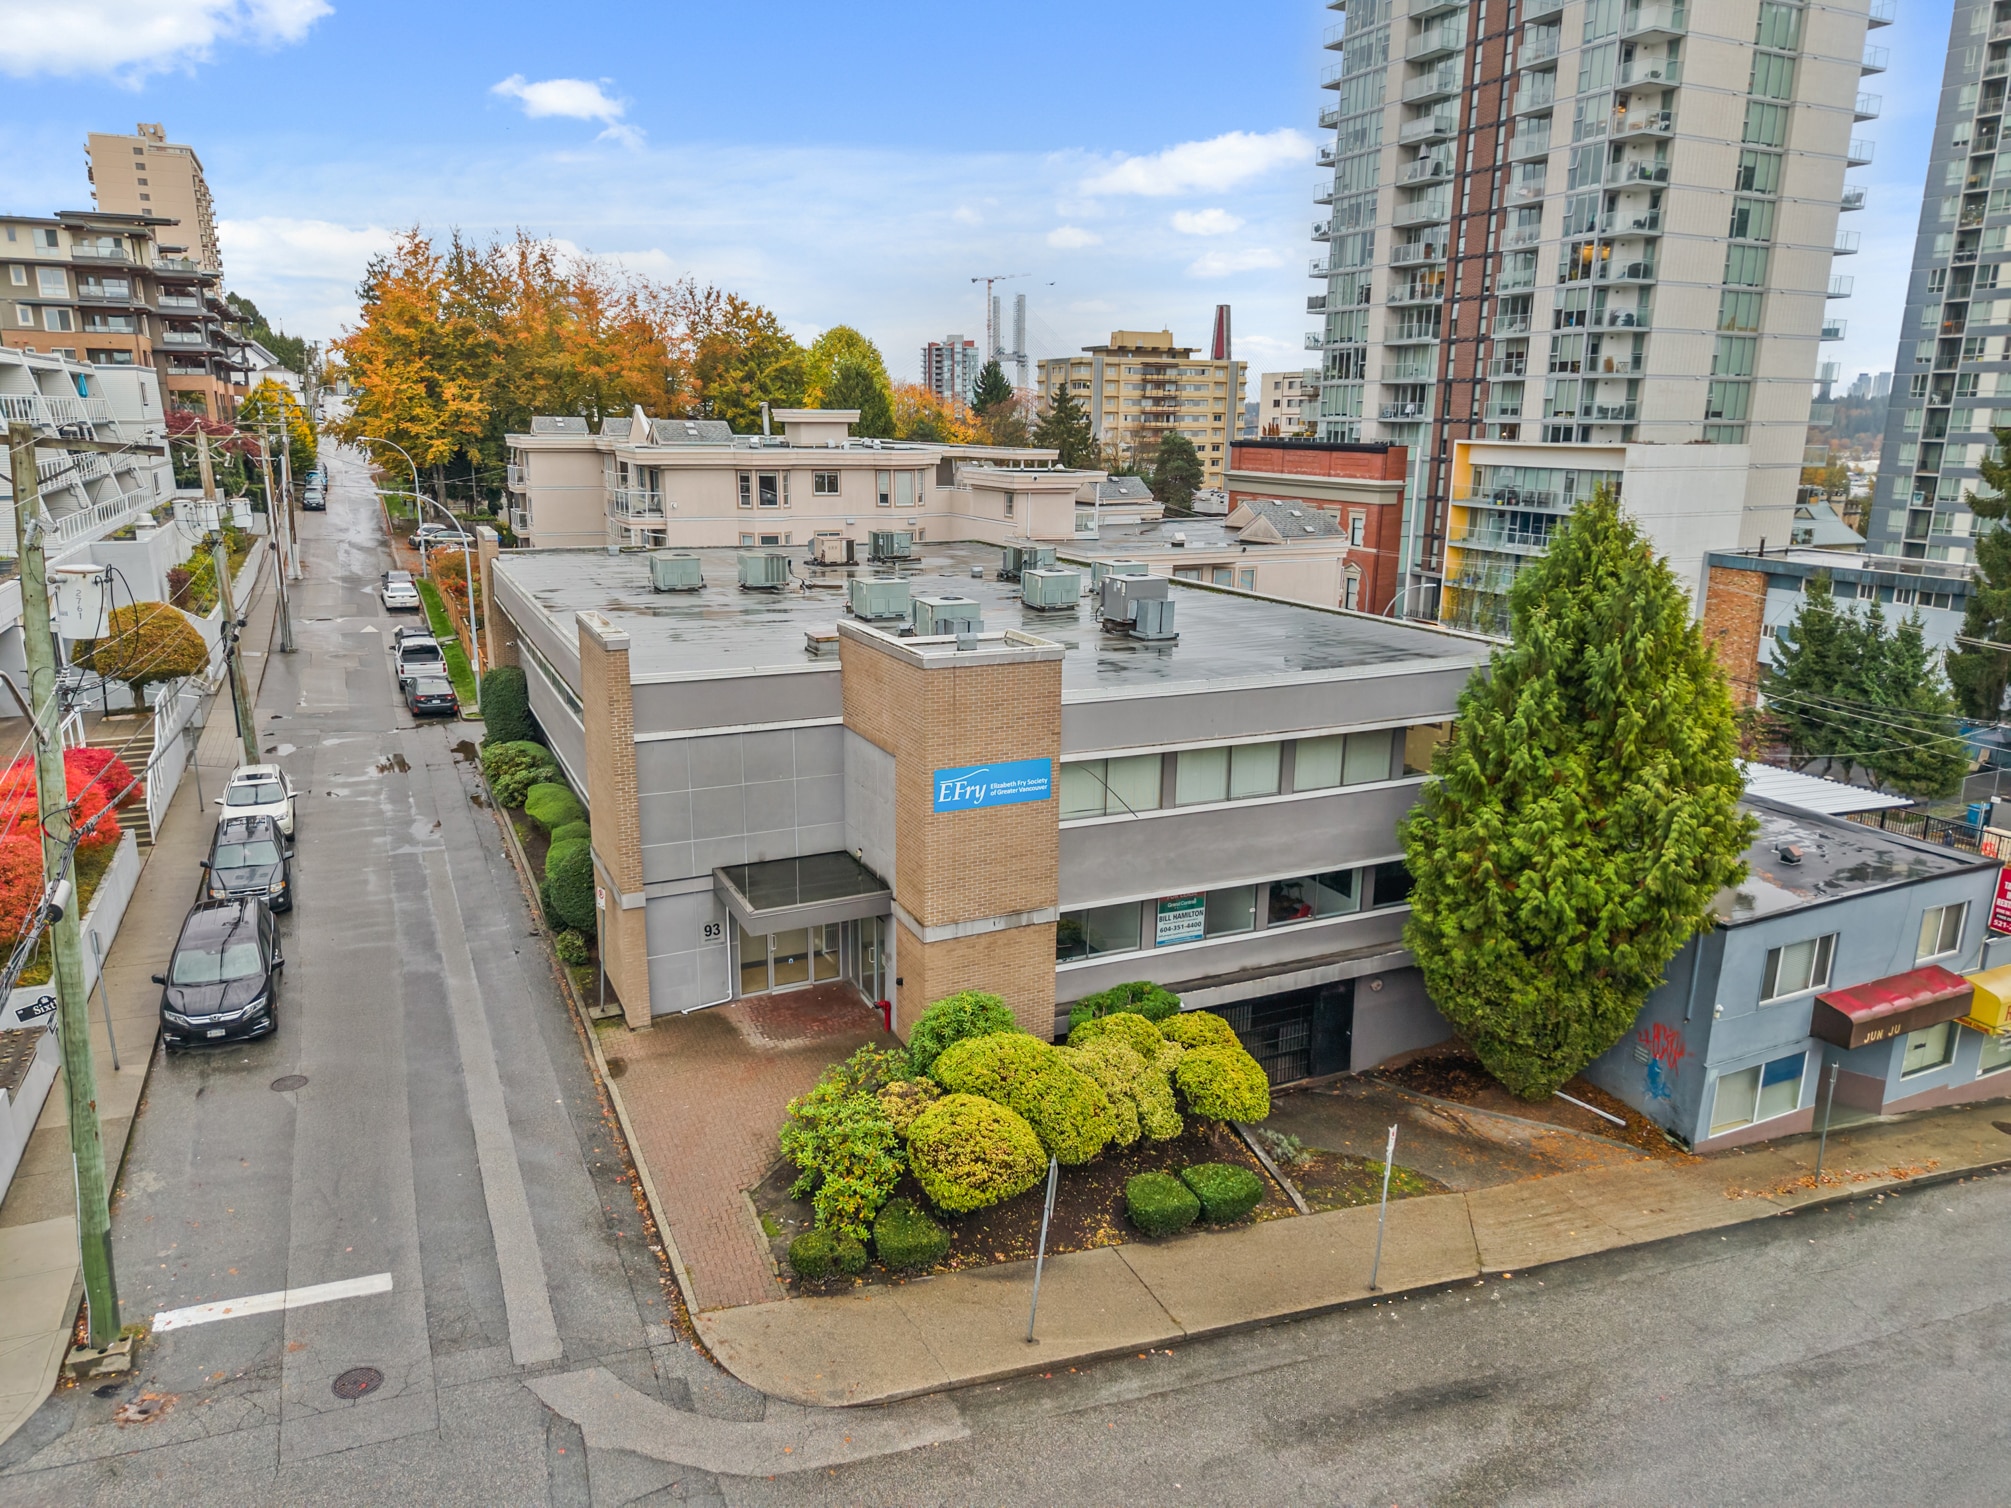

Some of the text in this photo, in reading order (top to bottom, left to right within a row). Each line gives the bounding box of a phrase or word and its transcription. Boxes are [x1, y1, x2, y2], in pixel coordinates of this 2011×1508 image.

[75, 589, 83, 620] 2761
[990, 777, 1048, 789] Elizabeth Fry Society
[997, 787, 1018, 796] Greater
[1018, 784, 1048, 793] Vancouver
[1172, 910, 1204, 920] HAMILTON
[704, 923, 721, 937] 93
[1160, 922, 1202, 933] 604-351-4400
[1864, 1024, 1901, 1043] JUN JU
